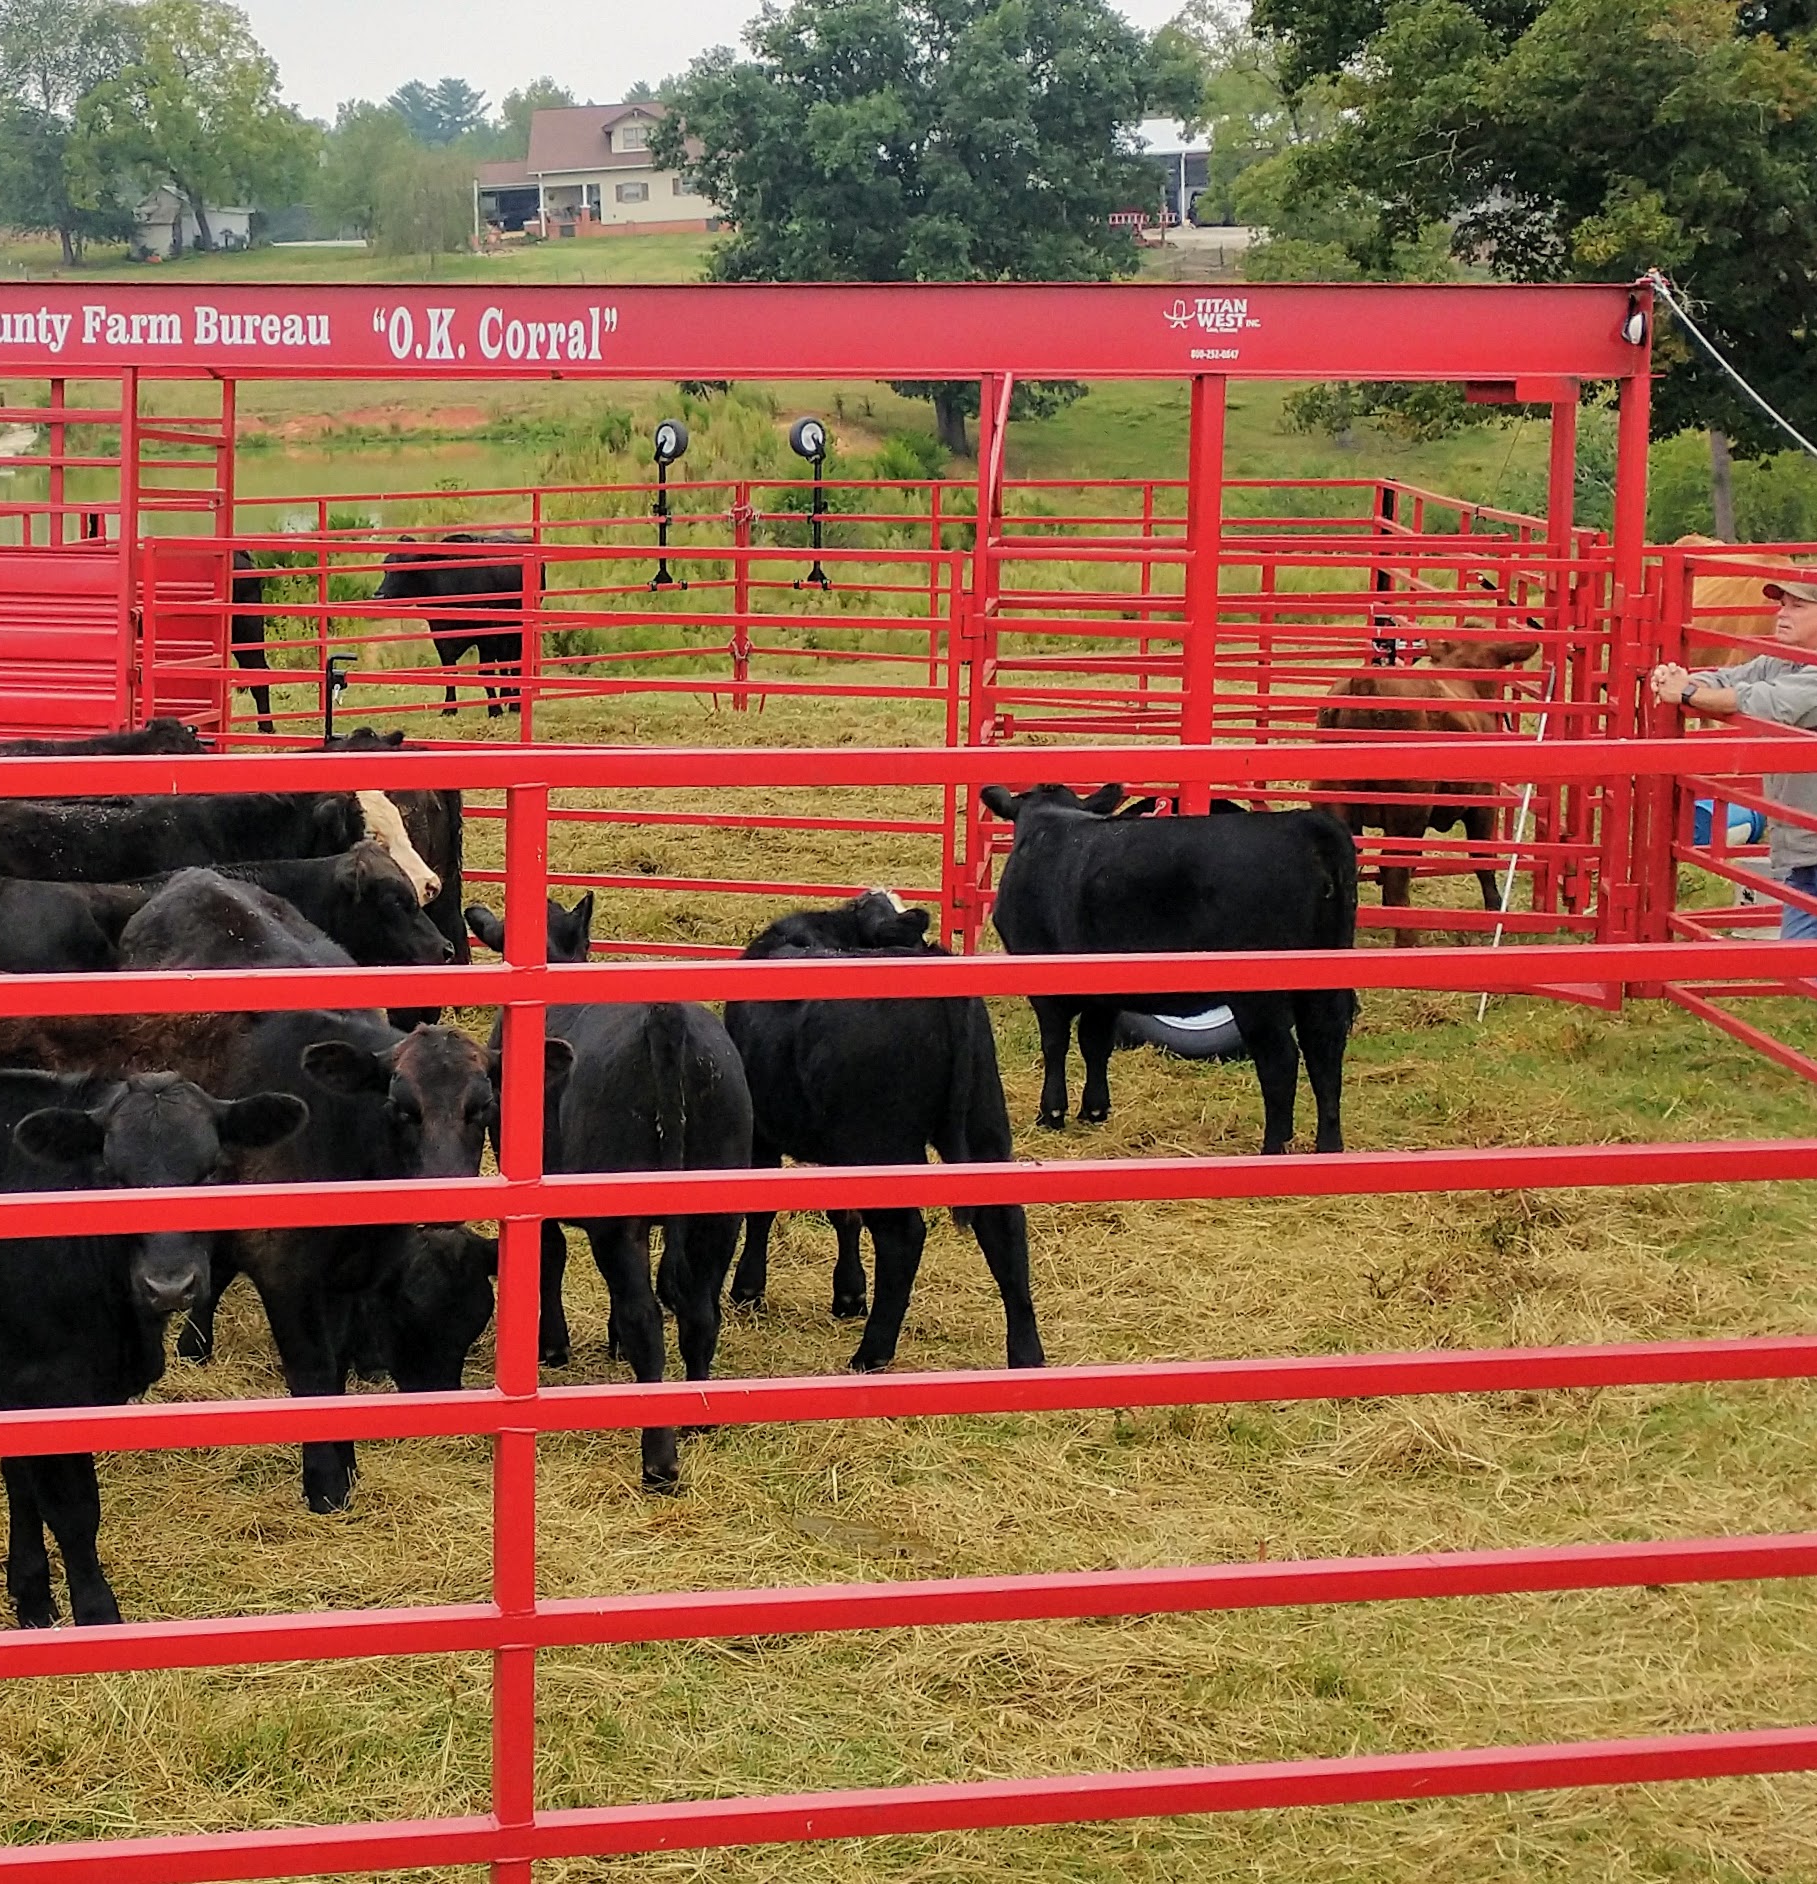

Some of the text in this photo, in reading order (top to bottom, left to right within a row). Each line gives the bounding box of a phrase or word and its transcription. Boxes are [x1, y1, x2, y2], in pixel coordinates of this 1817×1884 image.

[1195, 299, 1248, 314] TITAN
[82, 305, 183, 345] Farm
[194, 306, 331, 346] Bureau
[1197, 314, 1248, 327] WEST
